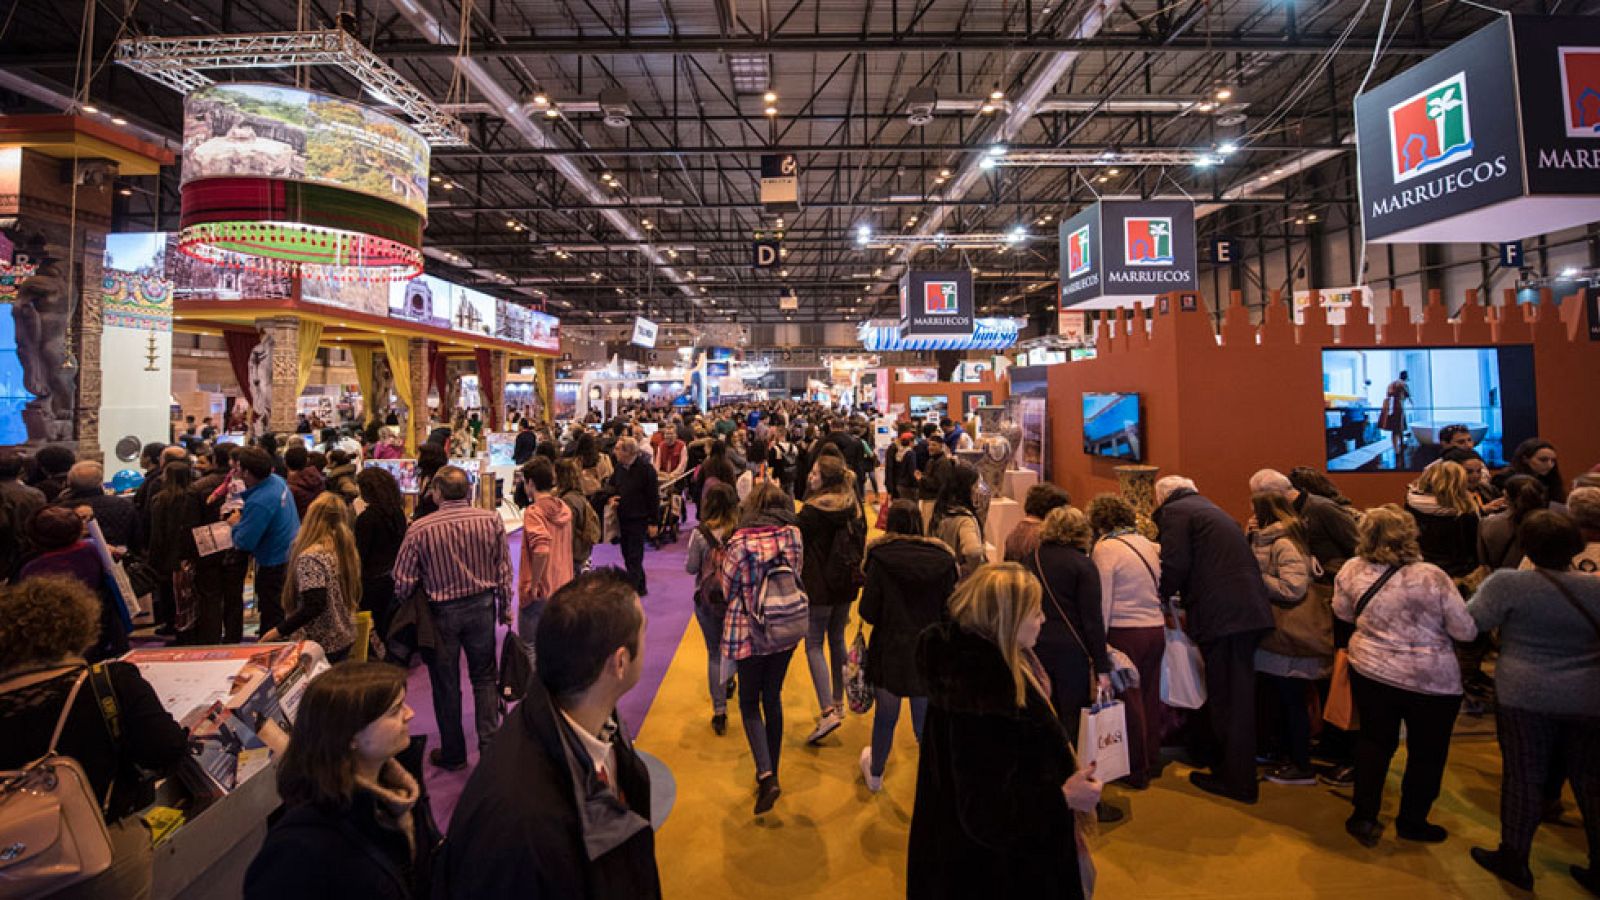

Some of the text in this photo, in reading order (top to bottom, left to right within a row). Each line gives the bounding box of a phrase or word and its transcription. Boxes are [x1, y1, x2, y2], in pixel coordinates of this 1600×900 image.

[1371, 156, 1508, 218] MARRUECOS
[758, 245, 775, 265] D
[1217, 241, 1231, 262] E
[1506, 244, 1517, 264] F
[1108, 270, 1191, 283] MARRUECOS
[913, 316, 970, 326] MARRUECOS
